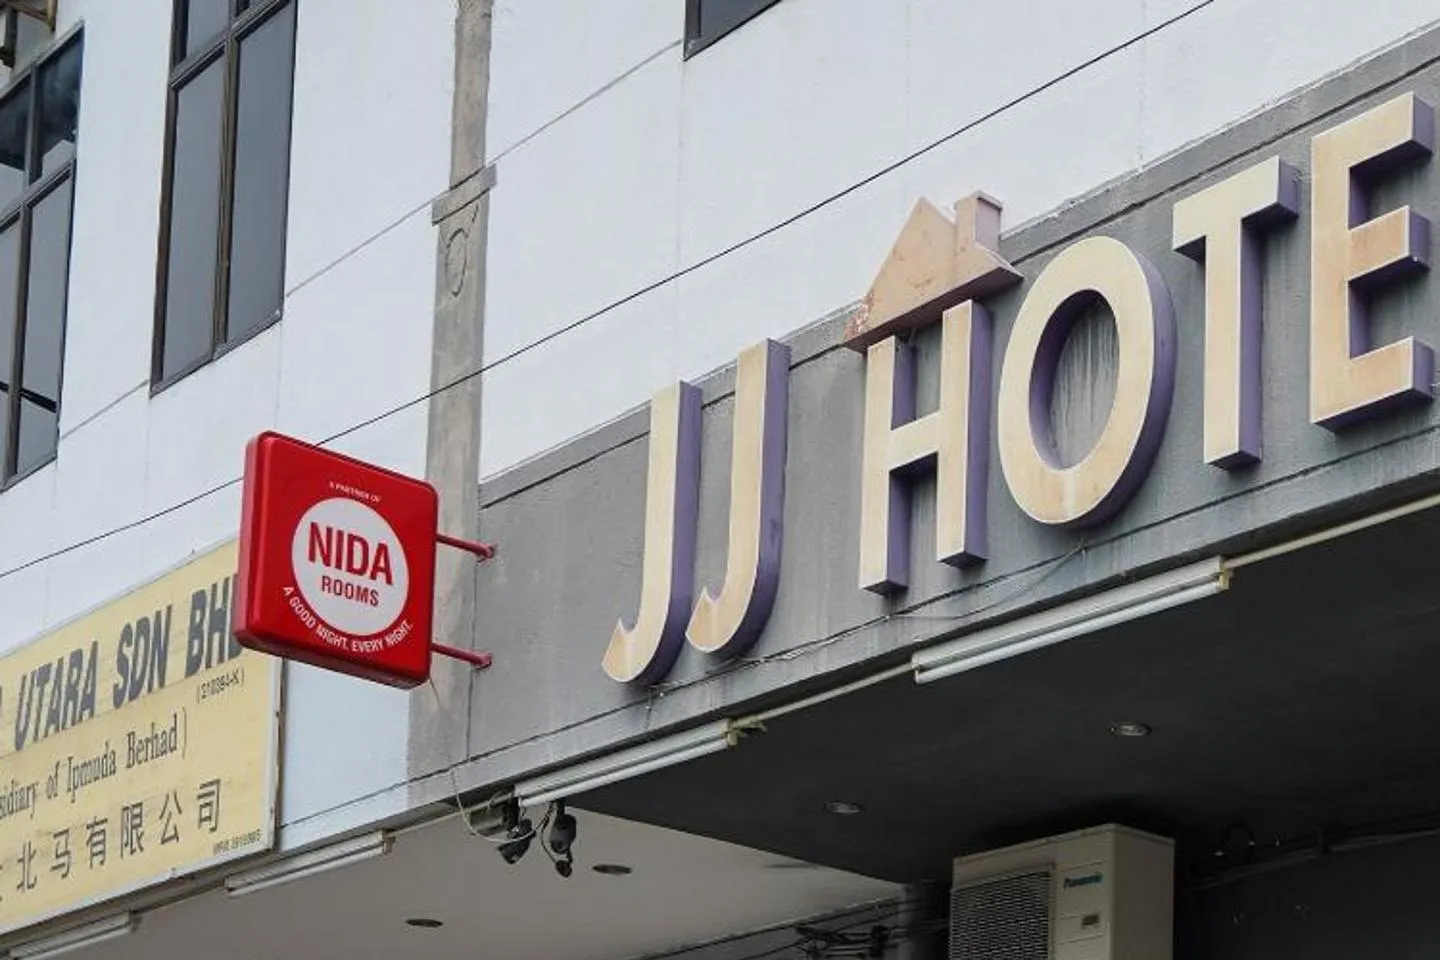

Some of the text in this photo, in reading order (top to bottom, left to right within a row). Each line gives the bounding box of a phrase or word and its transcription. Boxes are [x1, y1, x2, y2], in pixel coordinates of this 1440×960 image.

[602, 337, 791, 690] JJ
[308, 522, 393, 586] NIDA
[283, 586, 294, 597] A
[289, 596, 316, 630] GOOD
[351, 639, 384, 653] EVERY
[321, 576, 379, 607] ROOMS
[14, 640, 99, 752] UTARA
[113, 604, 173, 709] SDN
[46, 761, 60, 799] of
[0, 778, 221, 893] 北马有限公司
